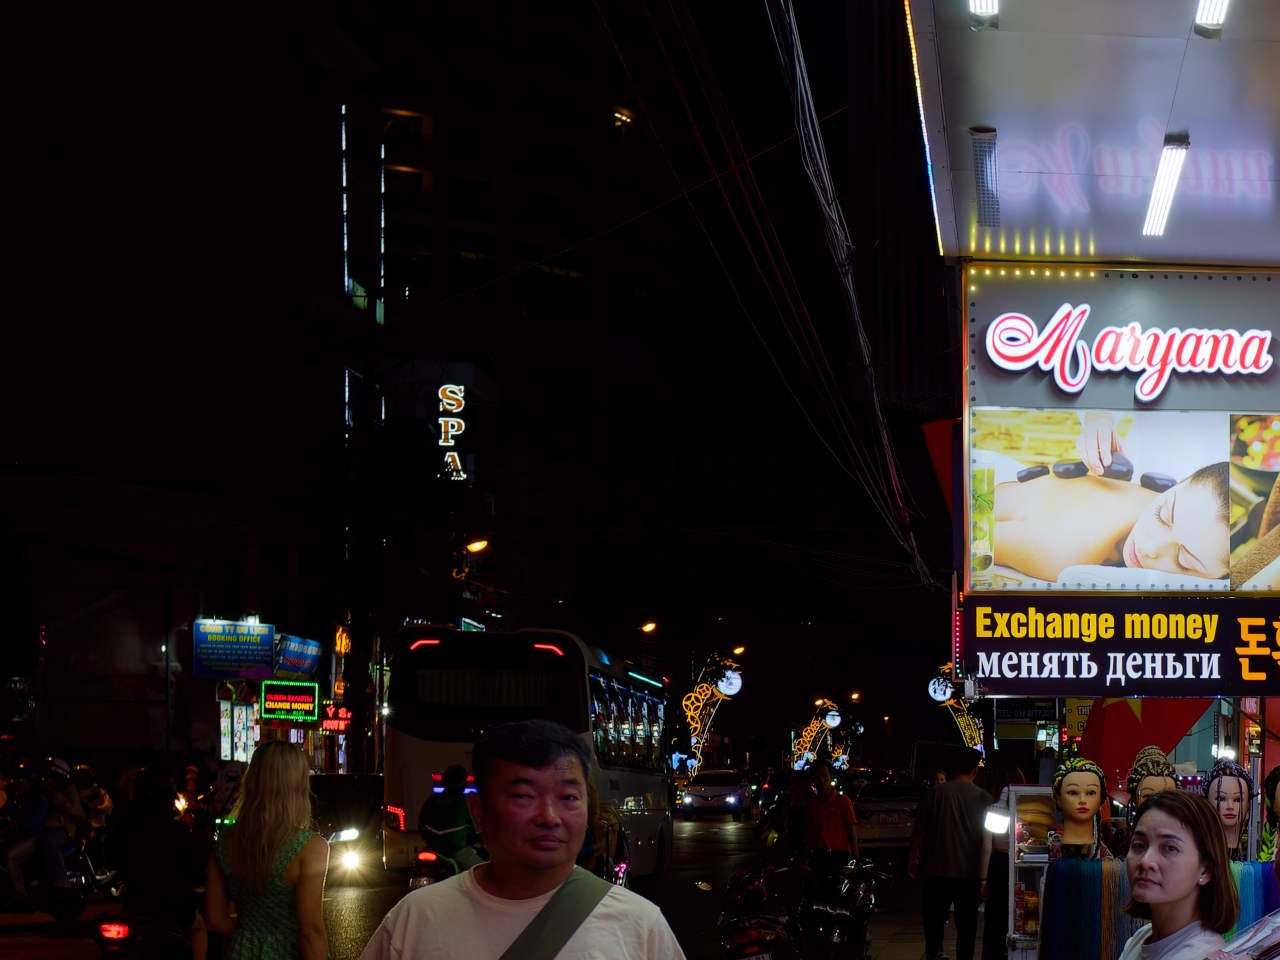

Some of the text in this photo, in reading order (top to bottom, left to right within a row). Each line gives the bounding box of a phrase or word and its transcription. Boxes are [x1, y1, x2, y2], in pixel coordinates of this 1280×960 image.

[986, 302, 1273, 404] Maryana
[438, 384, 467, 481] SPA
[976, 606, 1219, 645] Exchange money
[976, 647, 1221, 686] менять деньги
[265, 701, 314, 711] CHANGE MONEY
